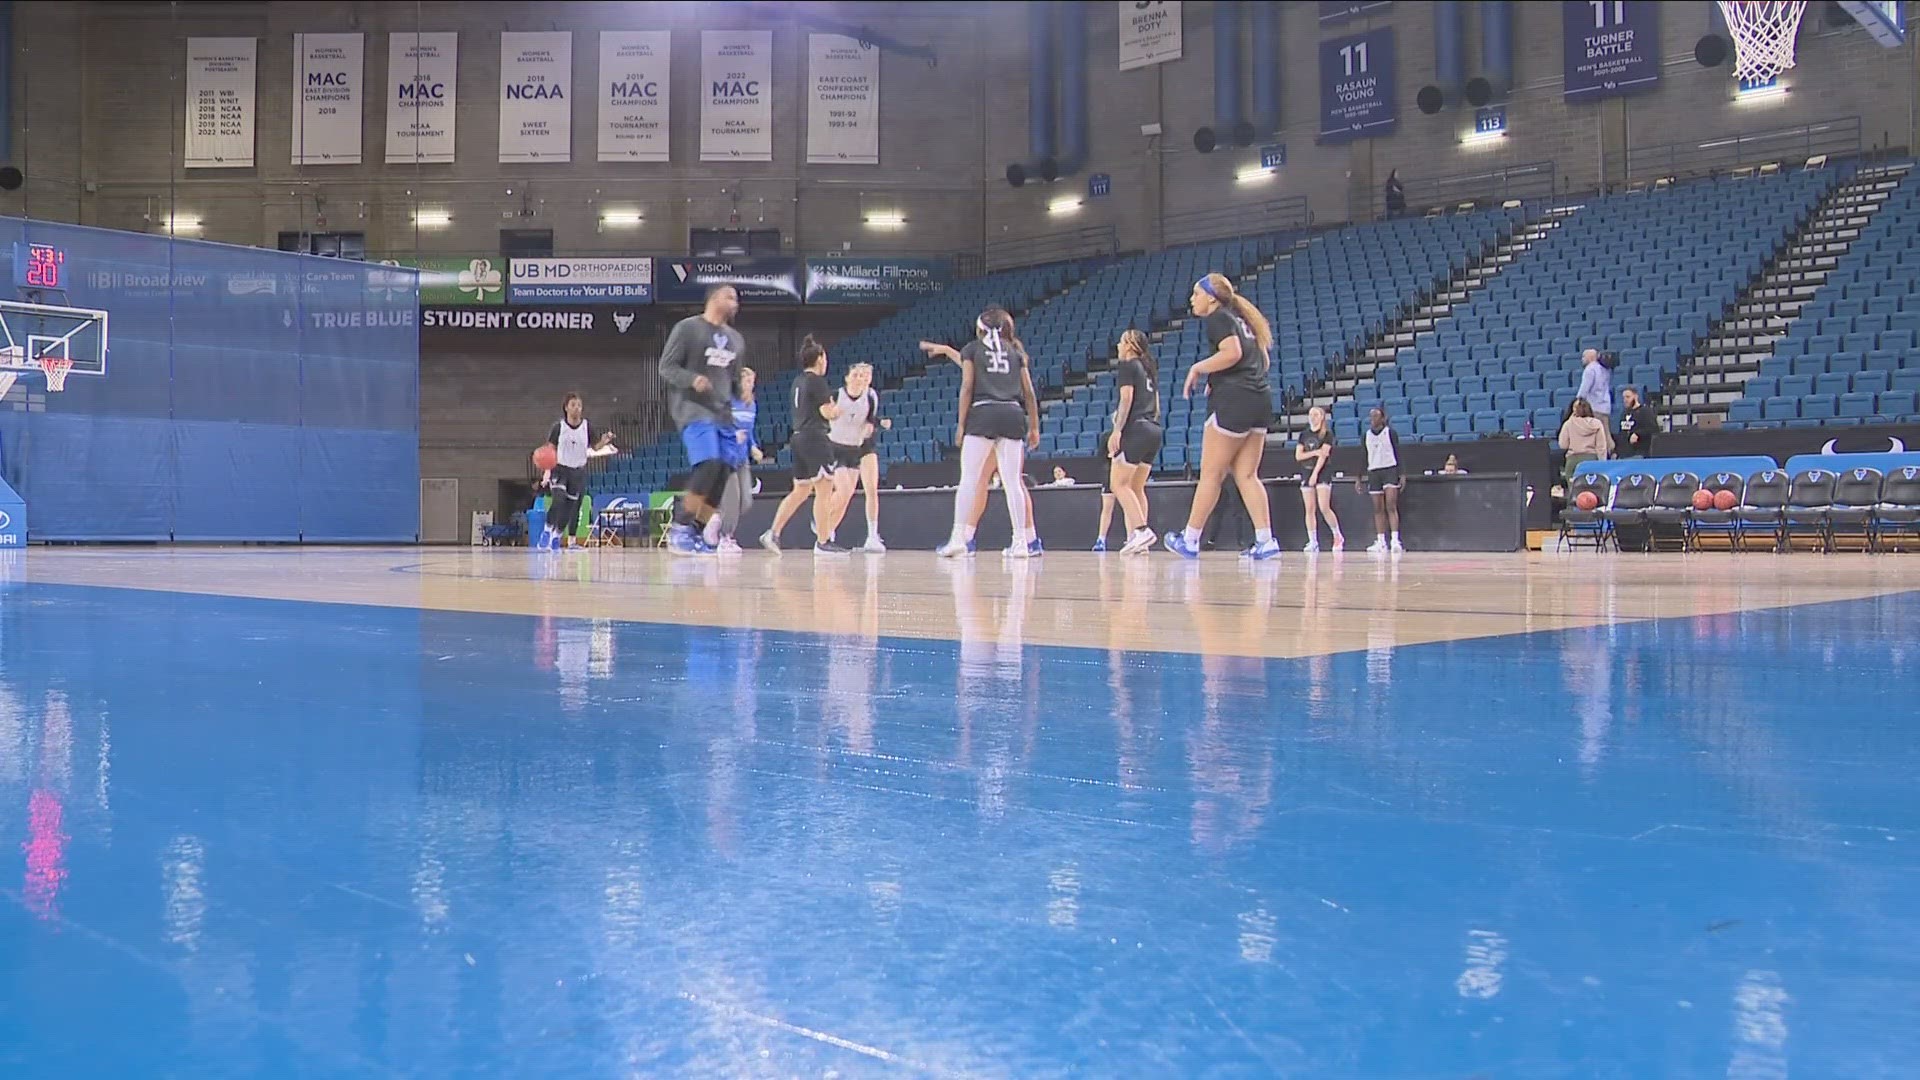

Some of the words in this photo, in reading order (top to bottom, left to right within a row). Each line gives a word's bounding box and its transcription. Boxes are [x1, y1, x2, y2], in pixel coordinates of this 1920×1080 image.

[1132, 10, 1168, 25] BRENNA
[1589, 1, 1624, 28] 11
[1138, 22, 1161, 33] DOTY
[1584, 30, 1634, 47] TURNER
[1586, 41, 1632, 58] BATTLE
[1339, 42, 1367, 76] 11
[1577, 62, 1597, 72] MEN'S
[1598, 56, 1643, 68] BASKETBALL
[308, 72, 347, 86] MAC
[1335, 77, 1377, 94] RASAUN
[399, 83, 444, 99] MAC
[506, 84, 563, 99] NCAA
[611, 82, 657, 98] MAC
[712, 81, 759, 97] MAC
[1338, 87, 1374, 102] YOUNG
[1481, 117, 1500, 130] 113
[1266, 153, 1282, 166] 112
[1093, 184, 1106, 194] 111
[28, 260, 57, 286] 20
[514, 263, 540, 278] UB
[545, 263, 571, 278] MD
[573, 263, 650, 272] ORTHOPAEDICS
[696, 264, 732, 272] VISION
[841, 265, 880, 277] Millard
[882, 265, 929, 277] Fillmore
[124, 272, 206, 287] Broadview
[306, 272, 328, 280] Care
[331, 272, 355, 280] Team
[513, 287, 535, 296] Team
[536, 287, 568, 296] Doctors
[569, 287, 582, 296] for
[583, 285, 607, 296] Your
[608, 286, 623, 296] UB
[624, 286, 648, 296] Bulls
[312, 312, 361, 328] TRUE
[366, 310, 413, 327] BLUE
[423, 310, 513, 329] STUDENT
[516, 312, 594, 330] CORNER
[985, 351, 1010, 374] 35
